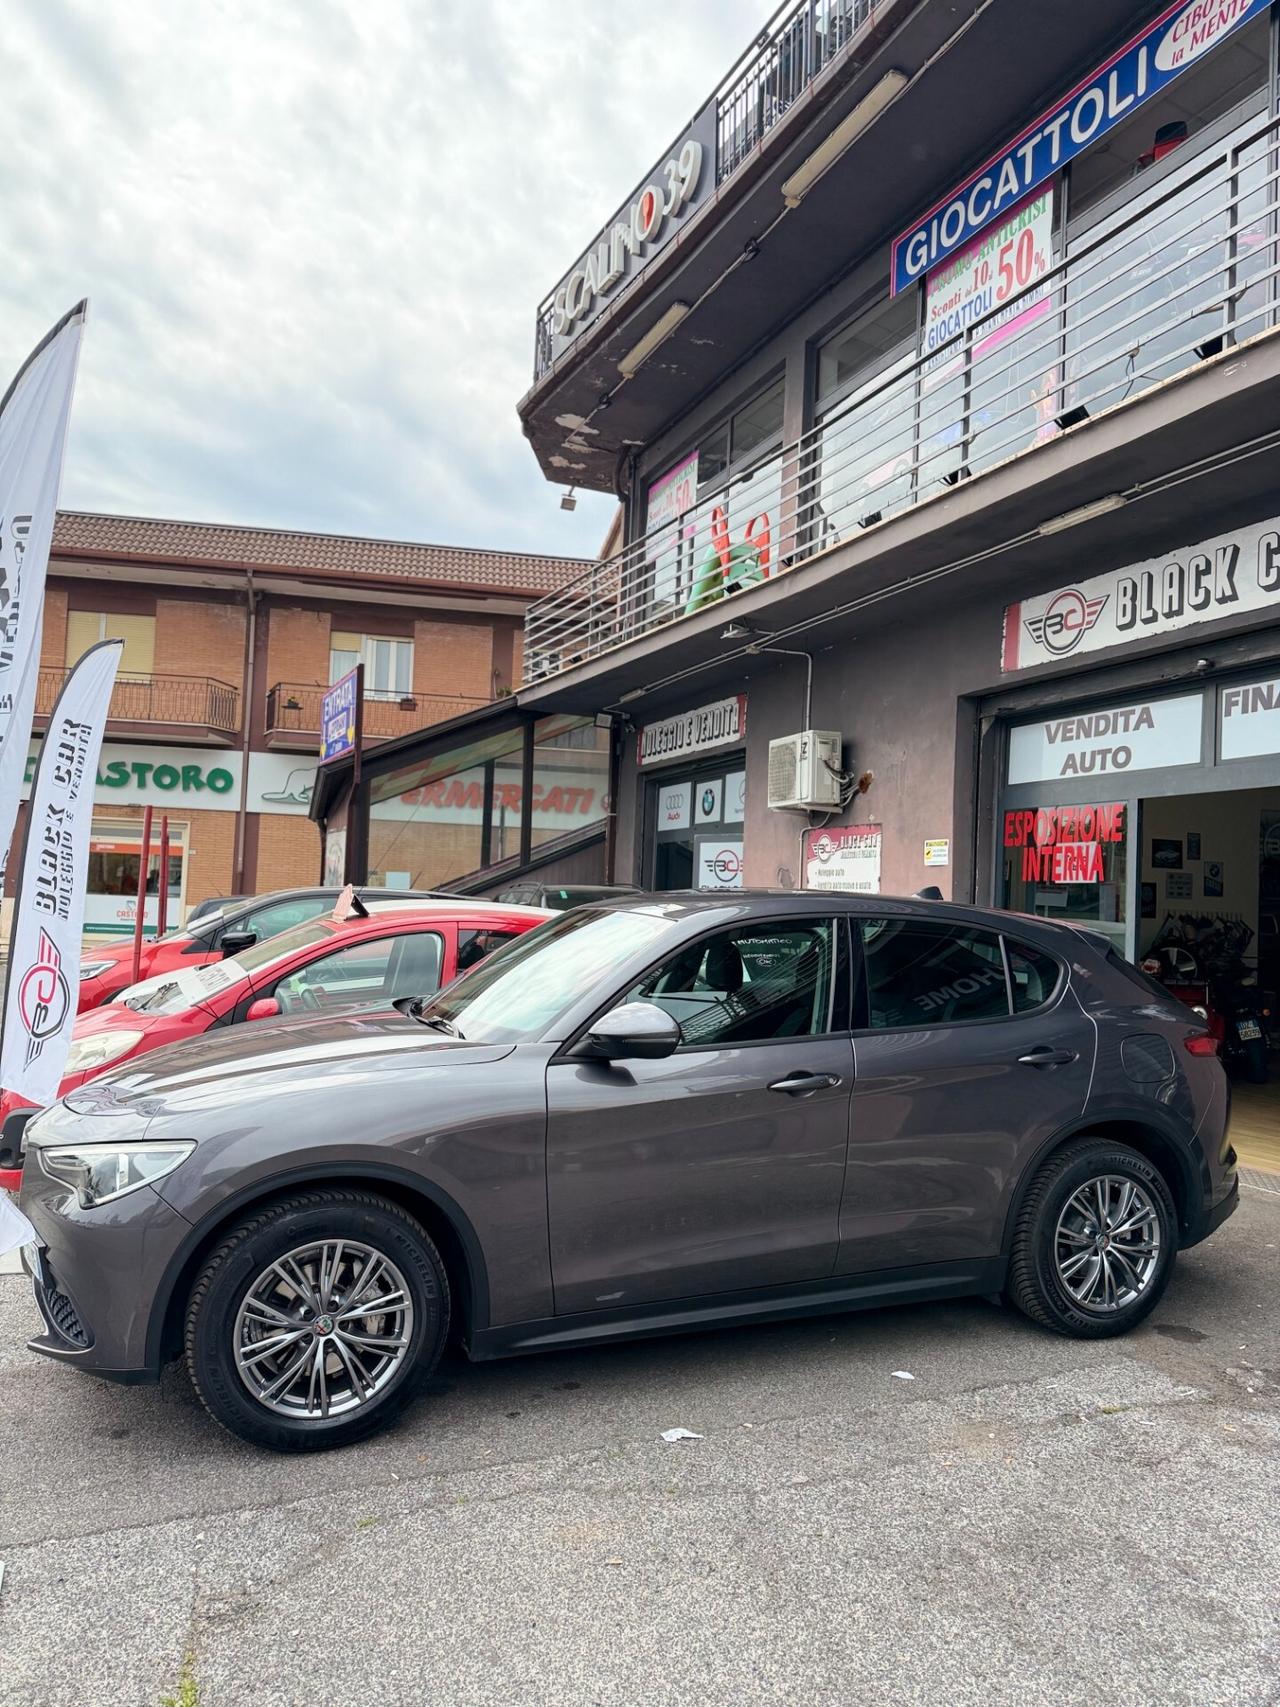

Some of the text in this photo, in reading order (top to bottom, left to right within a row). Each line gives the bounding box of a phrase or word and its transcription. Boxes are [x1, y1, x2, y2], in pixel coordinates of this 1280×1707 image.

[1172, 47, 1184, 66] la
[906, 46, 1147, 275] GIOCATTOLI
[554, 140, 703, 336] SCALINO 39
[928, 287, 993, 350] GIOCATTOLI
[931, 288, 962, 321] Sconti
[1116, 544, 1241, 632] BLACK
[641, 703, 739, 758] NOLEGGIO E VENDITA
[1045, 707, 1154, 744] VENDITA
[1060, 746, 1132, 776] AUTO
[33, 718, 81, 916] BLACK CAR
[58, 724, 93, 921] NOLEGGIO E VENDITA
[1003, 804, 1124, 847] ESPOSIZIONE
[1021, 842, 1105, 882] INTERNA
[395, 1232, 434, 1297] MICHELIN
